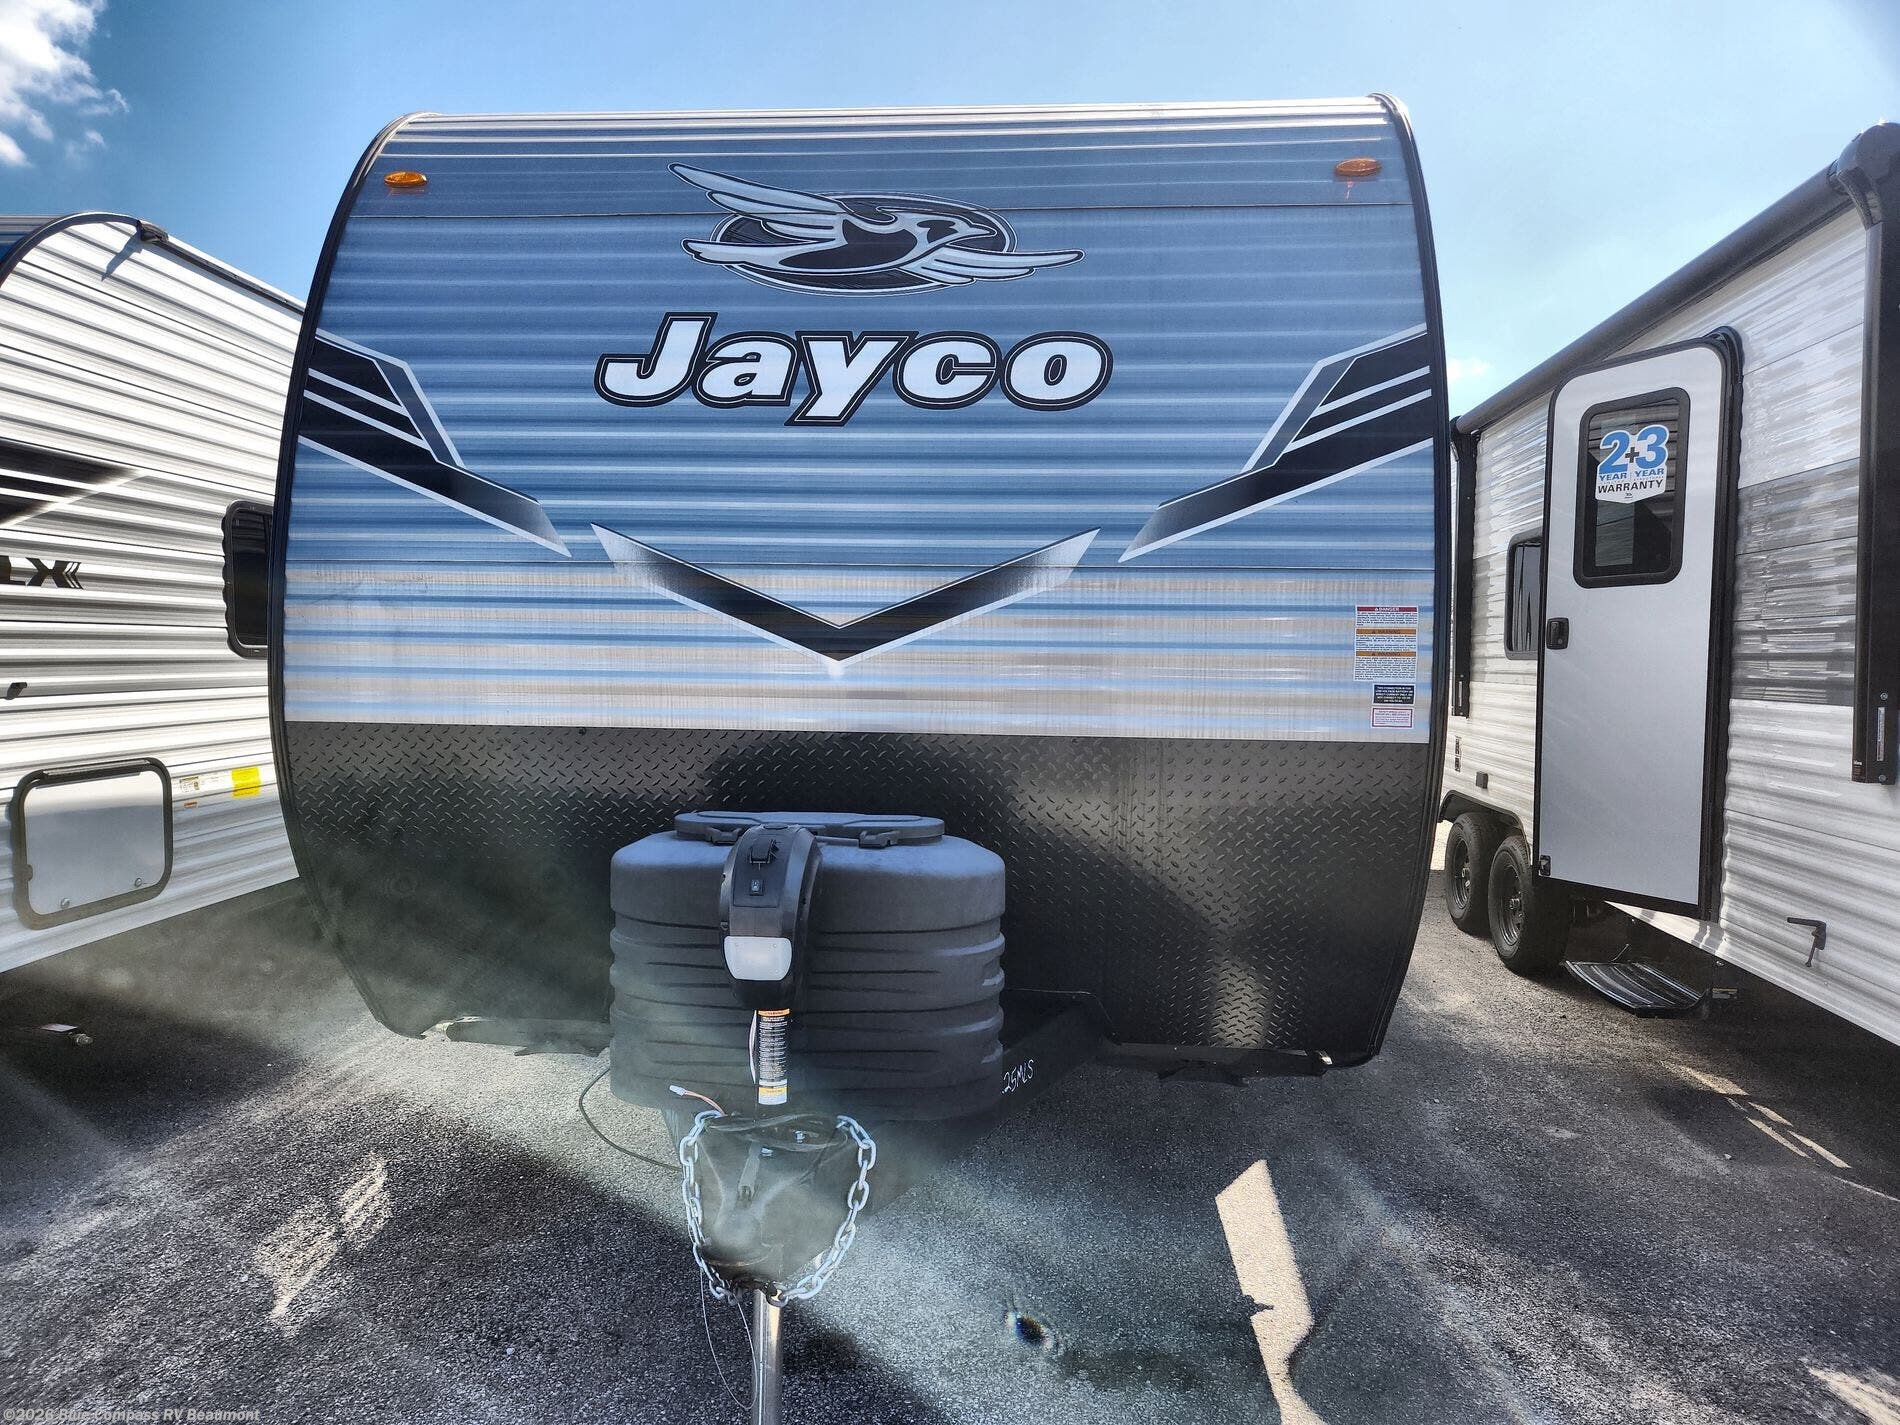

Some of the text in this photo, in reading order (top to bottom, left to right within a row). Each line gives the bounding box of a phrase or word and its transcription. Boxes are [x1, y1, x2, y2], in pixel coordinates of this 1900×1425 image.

[595, 312, 1113, 427] Jayco
[1600, 473, 1627, 481] YEAR
[1635, 468, 1664, 477] YEAR
[1598, 480, 1663, 493] WARRANTY
